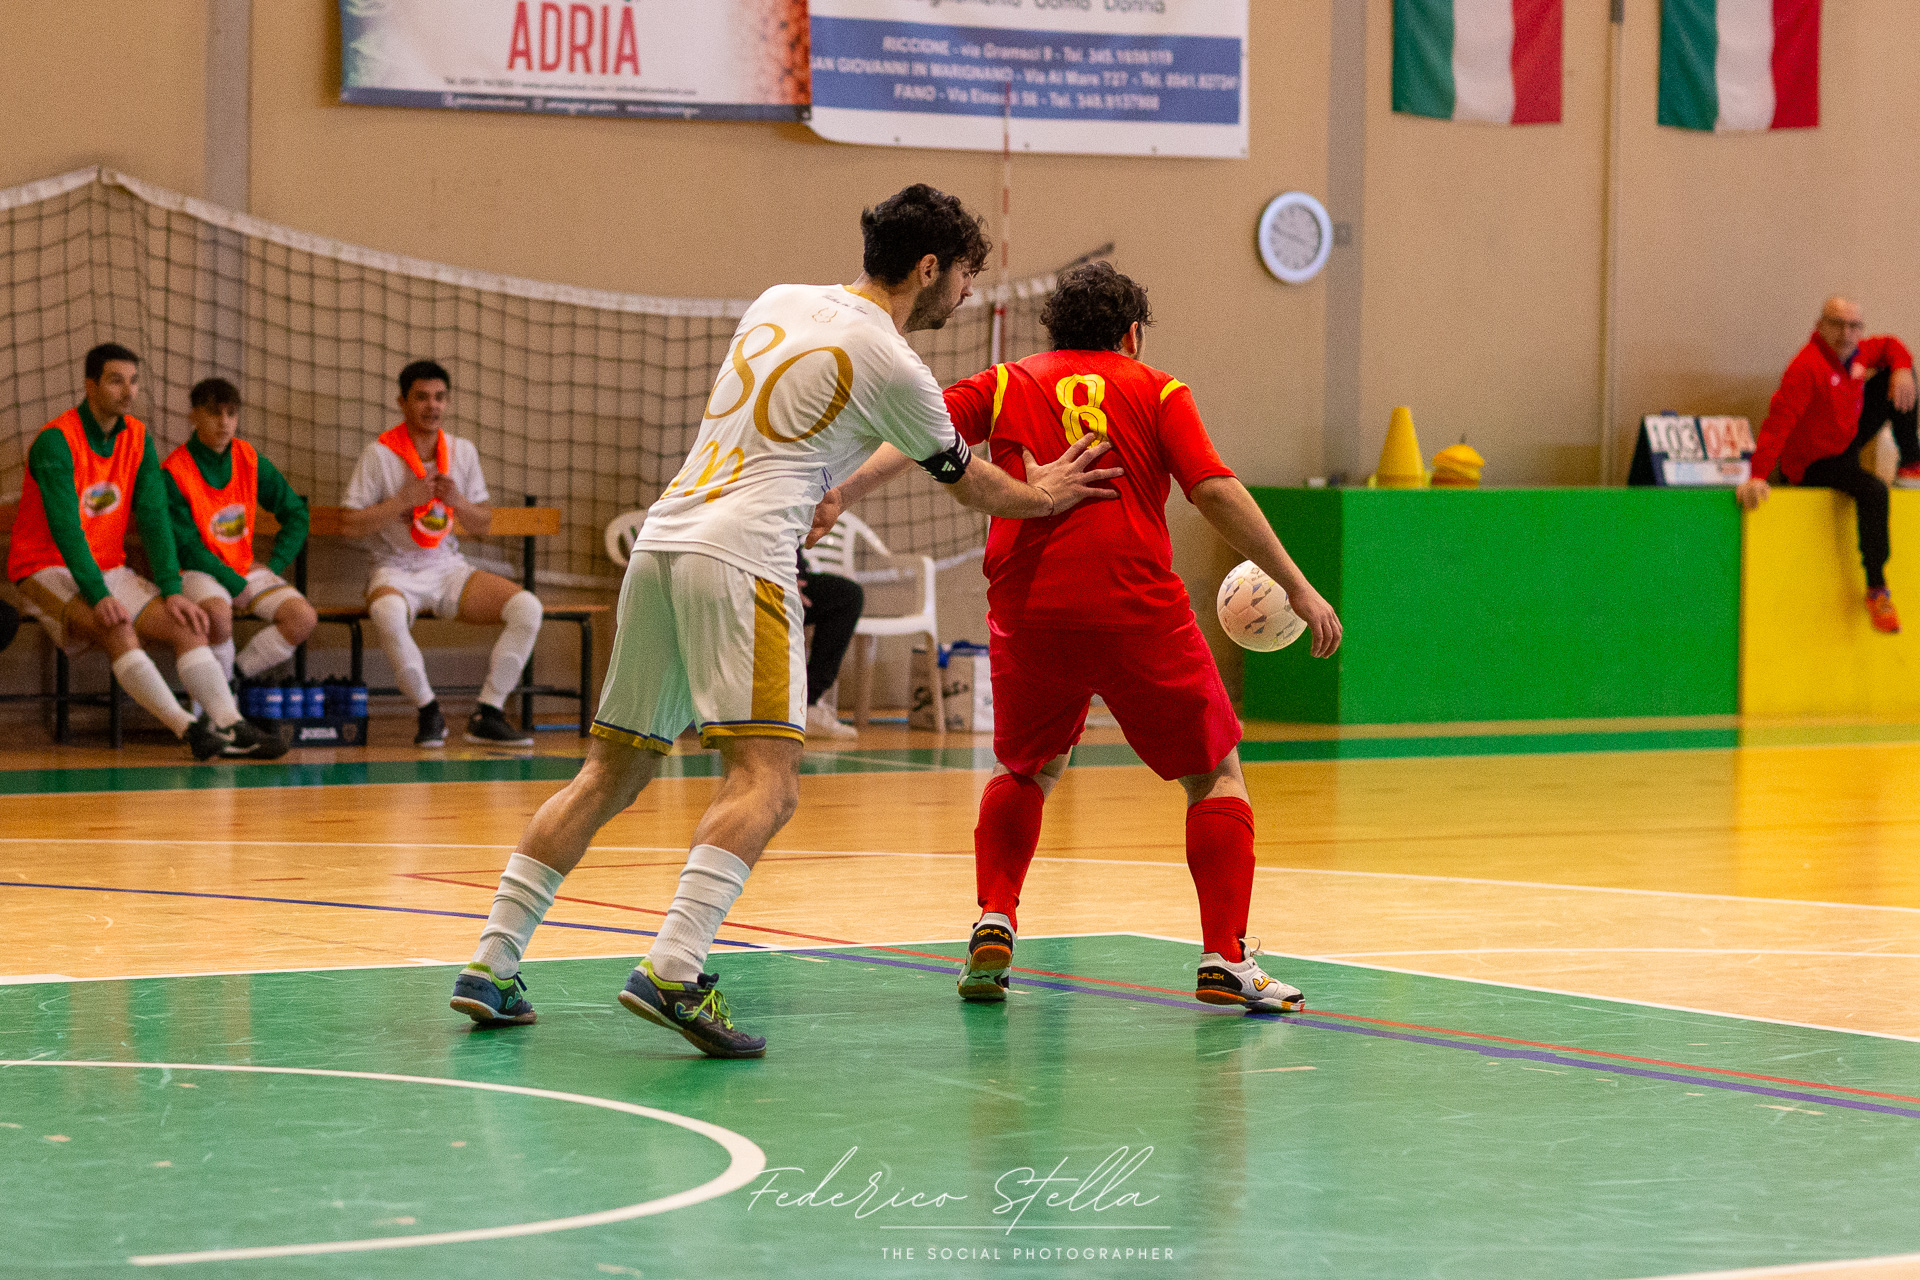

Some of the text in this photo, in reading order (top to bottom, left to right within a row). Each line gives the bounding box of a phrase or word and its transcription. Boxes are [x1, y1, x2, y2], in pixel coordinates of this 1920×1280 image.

[508, 1, 640, 75] ADRIA
[883, 36, 949, 56] RICCIONE
[837, 57, 910, 76] GIOVANNI
[929, 63, 1014, 82] MARIGNANO
[894, 83, 936, 101] FANO
[704, 323, 853, 443] 80
[1056, 374, 1108, 449] 8
